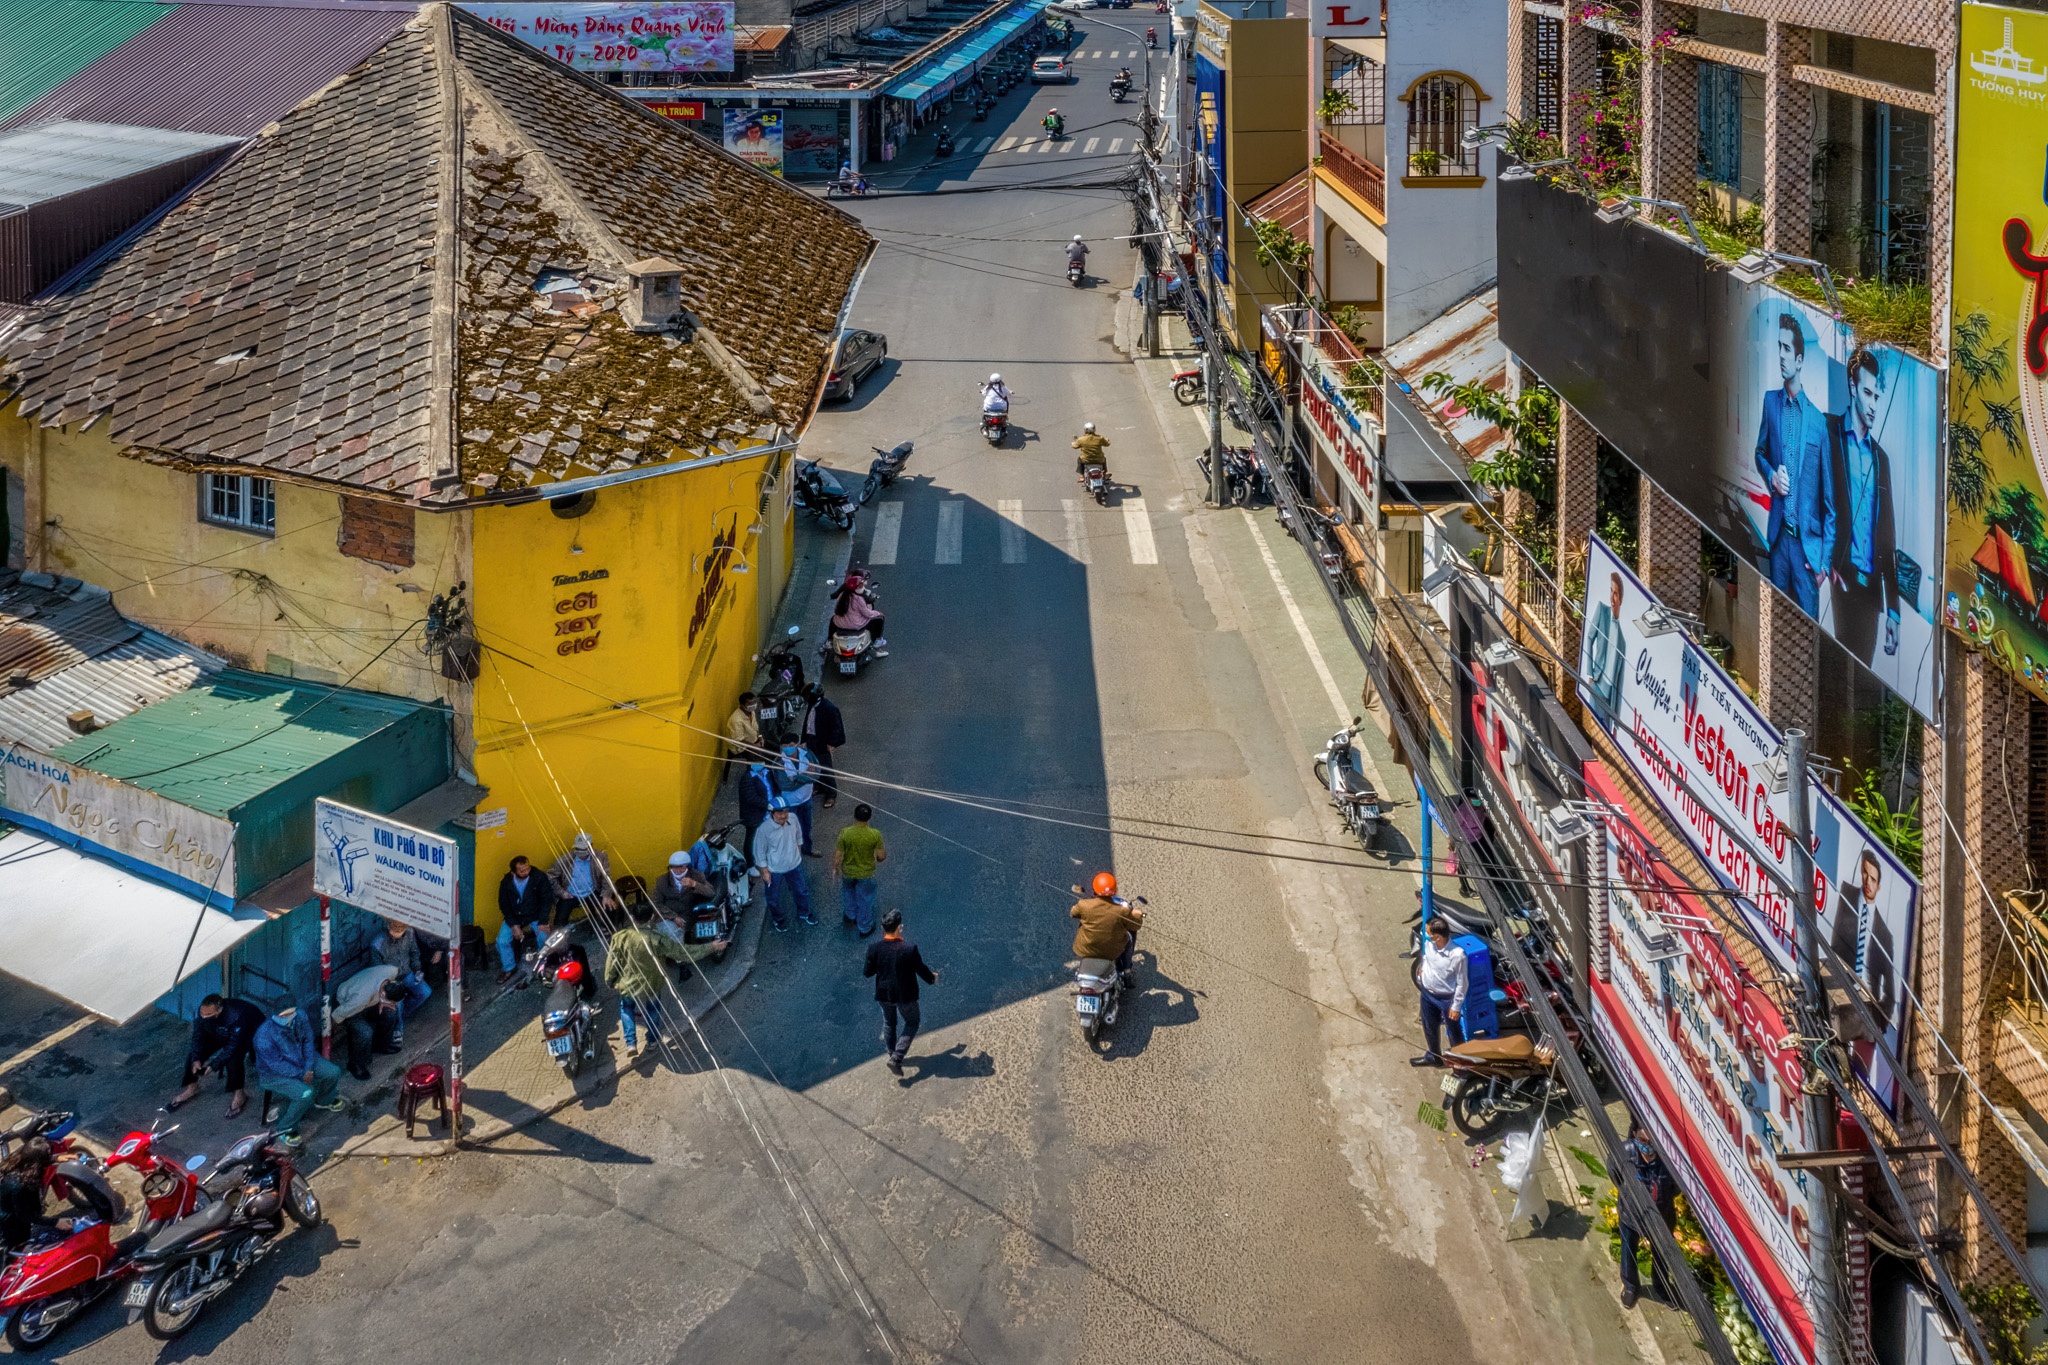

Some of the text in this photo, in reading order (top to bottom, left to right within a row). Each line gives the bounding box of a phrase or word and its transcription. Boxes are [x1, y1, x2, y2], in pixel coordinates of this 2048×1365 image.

[535, 16, 579, 38] Mừng
[585, 15, 624, 38] Đảng
[630, 17, 682, 38] Quang
[688, 16, 726, 35] Vinh
[1326, 6, 1370, 26] L
[555, 45, 575, 64] Tý
[593, 45, 639, 62] 2020
[669, 106, 695, 116] TRƯNG
[1970, 78, 2047, 102] TƯỜNG HUY
[1635, 648, 1671, 714] Chuyên
[1682, 650, 1770, 759] ĐẠI LÝ TIẾN PHƯƠNG
[42, 764, 71, 785] HOÁ
[1633, 706, 1672, 792] Veston
[1674, 765, 1714, 857] Phong
[1684, 682, 1786, 864] Veston Cao
[32, 782, 120, 834] Ngọc
[374, 827, 446, 870] KHU PHỐ ĐI BỘ
[375, 853, 445, 887] WALKING TOWN
[1621, 827, 1656, 885] HÀNG
[1691, 930, 1738, 1001] TRANG
[1742, 1001, 1779, 1059] CAO
[1711, 1032, 1757, 1109] TÂY
[1662, 991, 1744, 1149] Veston
[1745, 1132, 1789, 1217] Cao
[1717, 1138, 1732, 1169] CƠ
[1734, 1167, 1766, 1226] QUAN
[1769, 1220, 1794, 1273] VĂN
